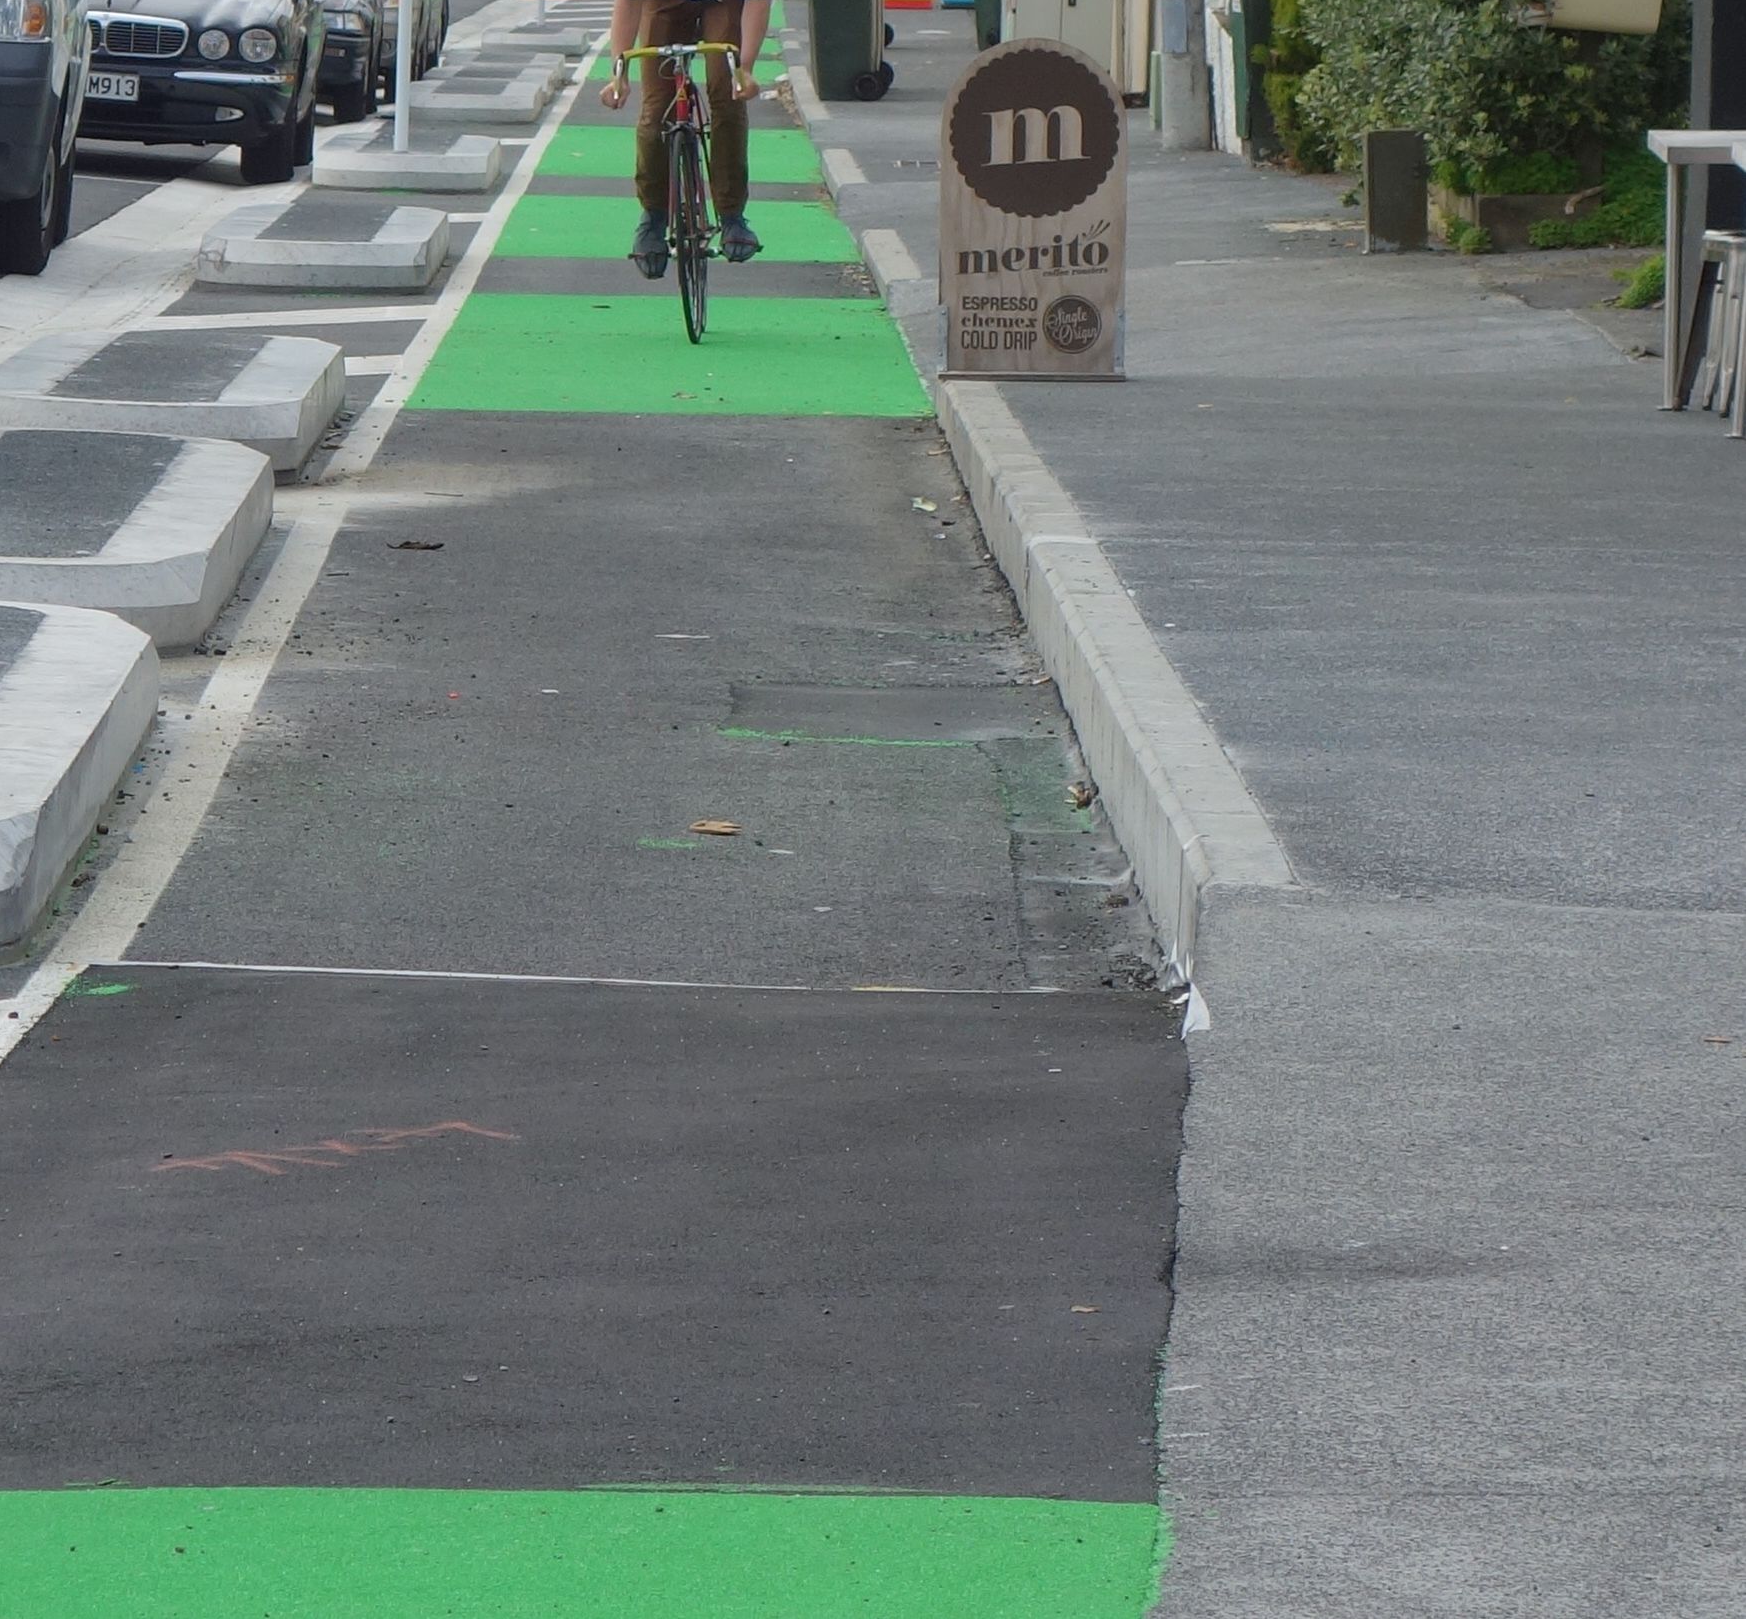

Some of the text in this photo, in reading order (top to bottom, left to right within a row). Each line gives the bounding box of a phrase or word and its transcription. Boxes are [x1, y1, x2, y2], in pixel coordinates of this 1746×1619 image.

[87, 75, 136, 97] M913
[981, 105, 1092, 167] m
[962, 296, 1038, 312] ESPRESSO
[961, 313, 1038, 328] chemex
[961, 330, 1038, 351] COLD DRIP
